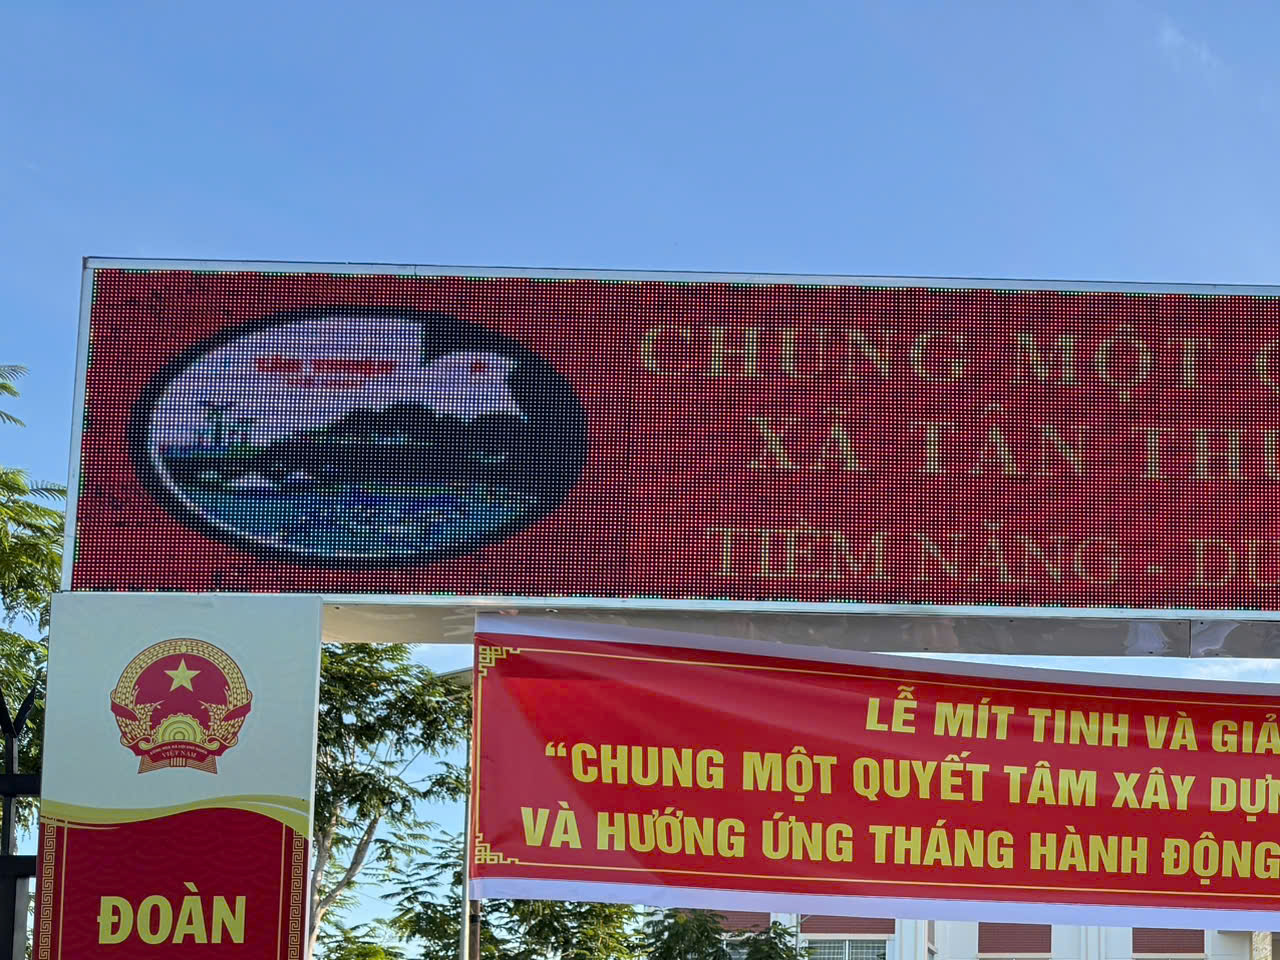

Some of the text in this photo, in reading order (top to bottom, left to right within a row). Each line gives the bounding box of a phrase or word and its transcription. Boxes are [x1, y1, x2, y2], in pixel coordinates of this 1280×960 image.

[638, 324, 969, 383] CHUNG
[1010, 323, 1213, 403] MỘT
[746, 407, 869, 472] XÃ
[909, 402, 1090, 477] TÂN
[911, 519, 1122, 585] NĂNG
[866, 685, 916, 734] LỄ
[934, 696, 1015, 740] MÍT
[1028, 708, 1129, 748] TINH
[1144, 711, 1198, 751] VÀ
[545, 742, 724, 790] “CHUNG
[743, 745, 837, 802] MỘT
[853, 752, 990, 802] QUYẾT
[1003, 763, 1098, 807] TÂM
[1113, 766, 1195, 811] XÂY
[521, 801, 582, 849] VÀ
[596, 807, 745, 858] HƯỚNG
[762, 811, 853, 863] ỨNG
[868, 819, 1014, 869] THÁNG
[1030, 826, 1147, 874] HÀNH
[1161, 831, 1280, 885] ĐỘNG
[97, 881, 247, 945] ĐOÀN
